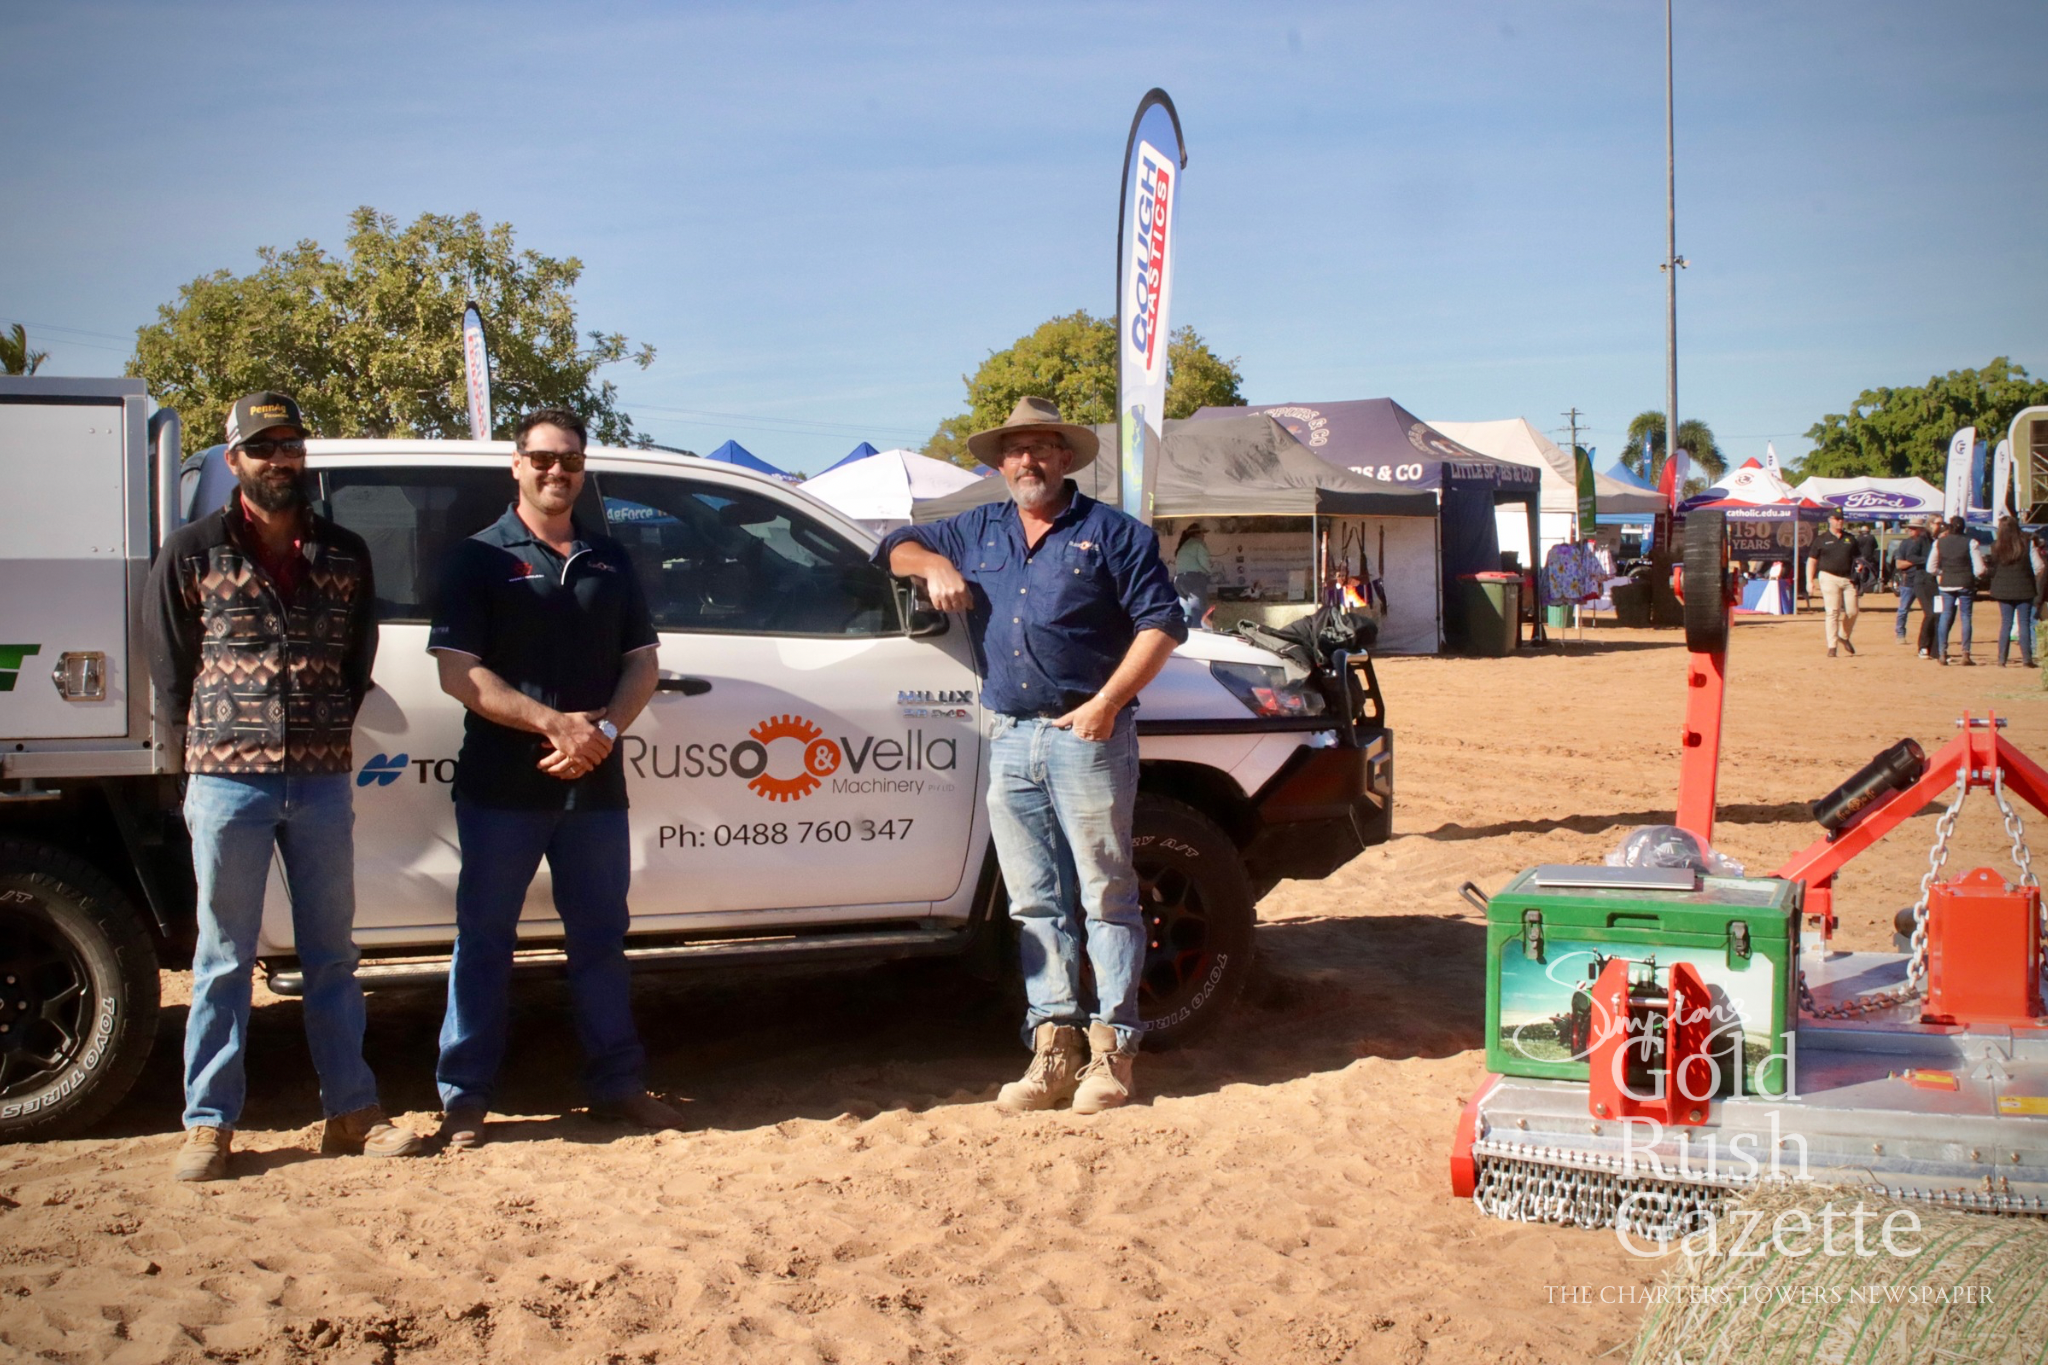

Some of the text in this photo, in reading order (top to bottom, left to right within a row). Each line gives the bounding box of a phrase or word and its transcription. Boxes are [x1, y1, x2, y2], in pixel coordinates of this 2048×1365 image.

[1131, 155, 1157, 354] GOUGH
[1145, 180, 1168, 363] LASTICS
[1376, 465, 1393, 482] &
[1396, 463, 1423, 481] CO
[1451, 463, 1484, 479] LITTLE
[1844, 490, 1905, 508] Ford
[606, 507, 653, 521] AgForce
[1734, 521, 1771, 538] 150
[1732, 540, 1771, 550] YEARS
[897, 690, 974, 704] HILUX
[839, 729, 957, 774] Vella
[832, 777, 925, 796] Machinery
[659, 818, 914, 848] Ph: 0488 760 347
[83, 996, 115, 1070] TOYO
[1, 1069, 86, 1119] TIRES
